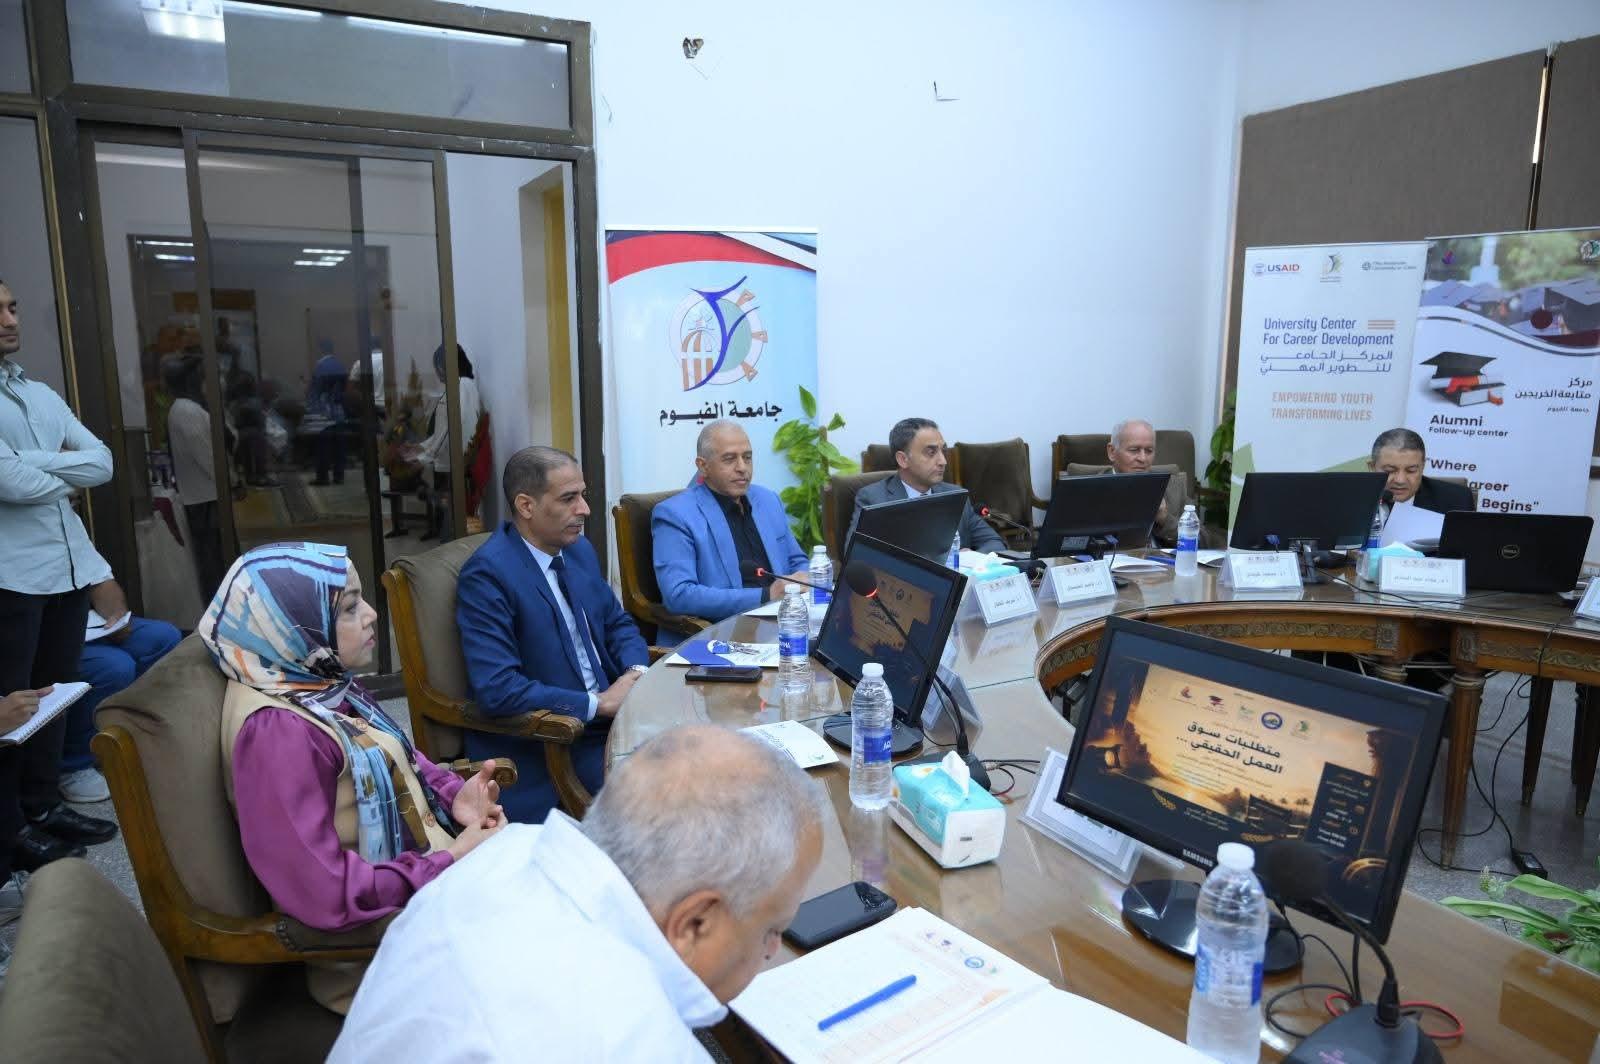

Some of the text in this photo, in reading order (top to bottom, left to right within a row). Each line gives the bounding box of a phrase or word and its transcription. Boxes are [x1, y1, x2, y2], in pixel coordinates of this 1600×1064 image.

[1267, 264, 1300, 272] USAID
[1264, 317, 1357, 332] University Center
[1263, 333, 1394, 347] For Career Development
[1260, 350, 1393, 364] المركز الجامعي
[1260, 363, 1392, 376] للتطوير المهني
[1568, 377, 1593, 388] مركز
[1271, 391, 1374, 405] EMPOWERING YOUTH
[1515, 389, 1591, 400] متابعة الخريجين
[659, 401, 783, 427] جامعة الفيوم
[1271, 407, 1373, 421] TRANSFORMING LIVES
[1430, 414, 1483, 426] Alumni
[1429, 426, 1509, 437] Follow-up center
[1467, 480, 1509, 492] areer
[1482, 498, 1539, 513] Begins"
[1187, 720, 1221, 738] سوق
[1190, 738, 1240, 760] الحقيقي
[1225, 733, 1281, 758] متطلبات
[1242, 755, 1283, 774] العمل
